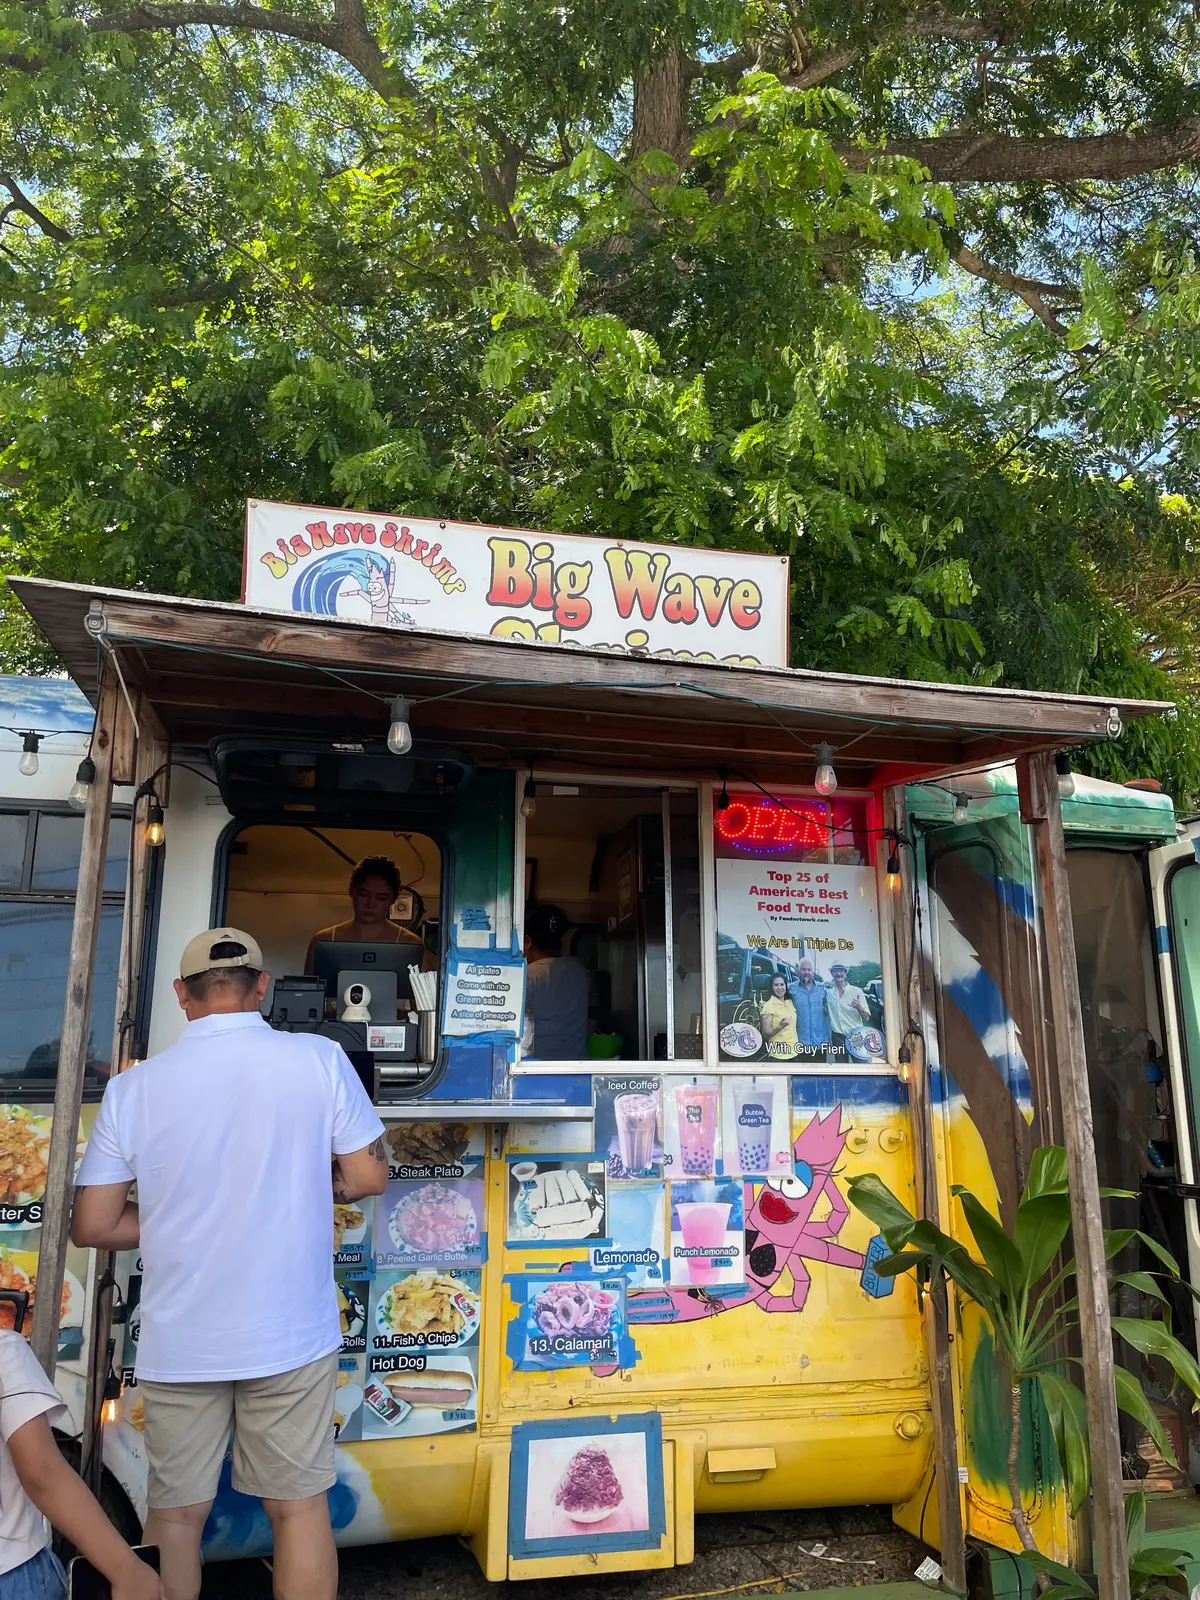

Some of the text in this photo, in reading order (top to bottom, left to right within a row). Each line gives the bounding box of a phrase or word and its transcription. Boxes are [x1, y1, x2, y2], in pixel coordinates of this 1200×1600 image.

[260, 521, 466, 595] Big Wave Shrimp
[486, 536, 762, 631] Big Wave
[718, 802, 833, 845] OPEN
[767, 870, 829, 883] Top 25 of
[749, 885, 848, 900] America's Best
[757, 901, 841, 915] Food Trucks
[747, 935, 854, 951] We Are In Triple Ds
[466, 965, 501, 976] All plates
[458, 980, 510, 991] Come with rice
[456, 994, 505, 1005] Green salad
[452, 1010, 458, 1018] A
[483, 1012, 516, 1021] pineapple
[765, 1042, 791, 1055] With
[795, 1042, 817, 1057] Guy
[821, 1043, 845, 1055] Fieri
[608, 1080, 659, 1091] Iced Coffee
[400, 1167, 431, 1177] Steak
[434, 1166, 462, 1177] Plate
[0, 1207, 24, 1220] ter
[338, 1253, 360, 1262] Meal
[377, 1253, 385, 1264] 8.
[387, 1253, 416, 1264] Peeled
[418, 1251, 442, 1262] Garlic
[596, 1251, 657, 1264] Lemonade
[675, 1246, 738, 1256] Punch Lemonade
[342, 1337, 366, 1347] Rolls
[375, 1333, 457, 1348] 11. Fish & Chips
[532, 1336, 611, 1353] 13. Calamari
[372, 1358, 394, 1371] Hot
[399, 1356, 424, 1370] Dog
